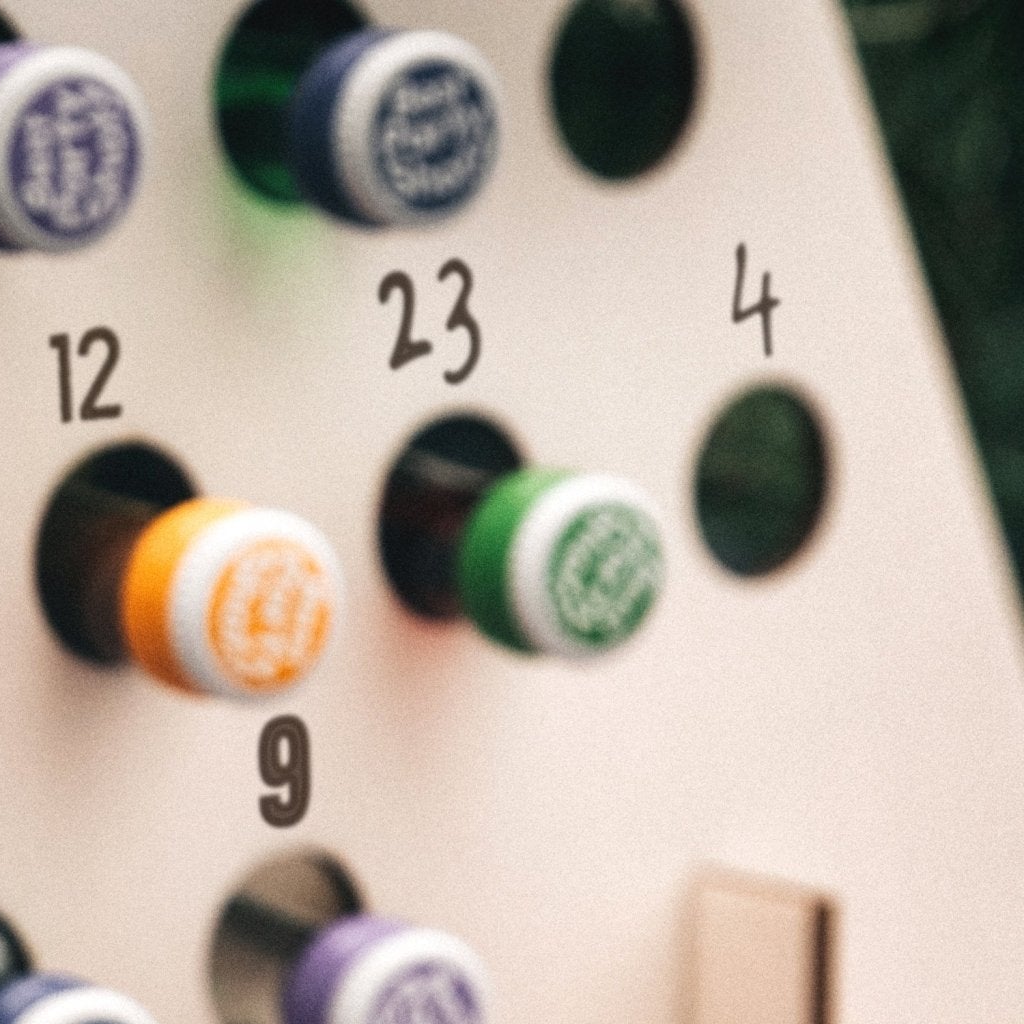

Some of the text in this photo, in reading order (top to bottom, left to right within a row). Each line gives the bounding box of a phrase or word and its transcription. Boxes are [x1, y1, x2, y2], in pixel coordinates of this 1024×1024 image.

[378, 258, 480, 385] 23
[730, 243, 780, 356] 4
[49, 326, 122, 424] 12
[257, 713, 312, 828] 9
